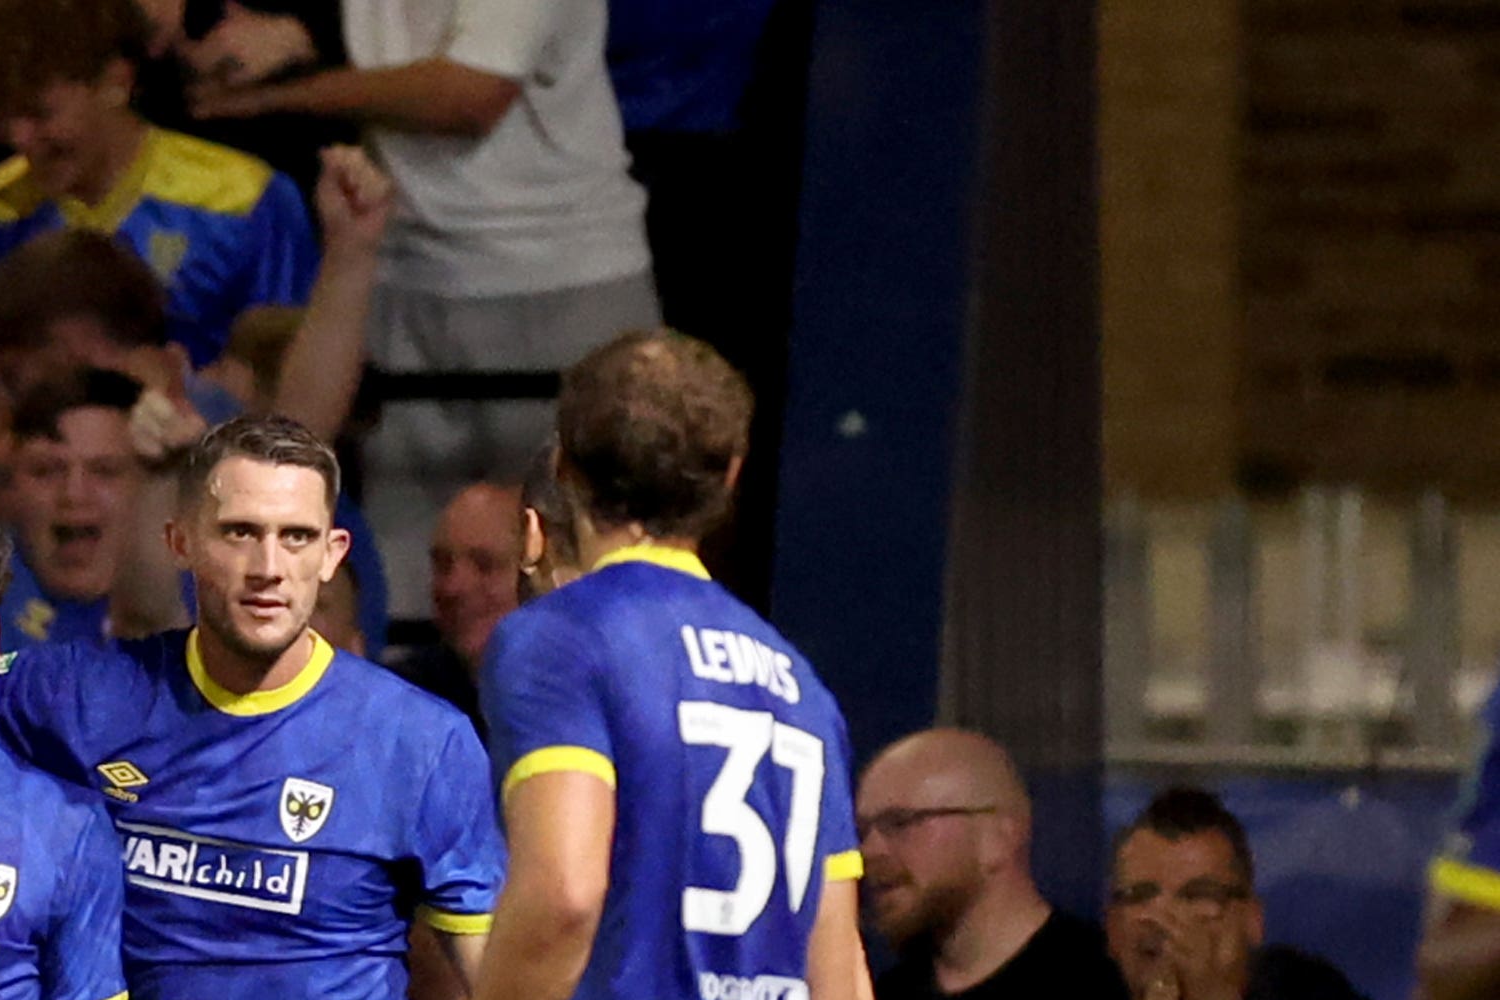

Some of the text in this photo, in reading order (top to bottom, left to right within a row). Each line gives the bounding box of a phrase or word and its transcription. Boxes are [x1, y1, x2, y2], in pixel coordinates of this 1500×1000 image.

[680, 624, 801, 705] LEWIS
[677, 700, 825, 935] 37
[195, 854, 291, 895] child
